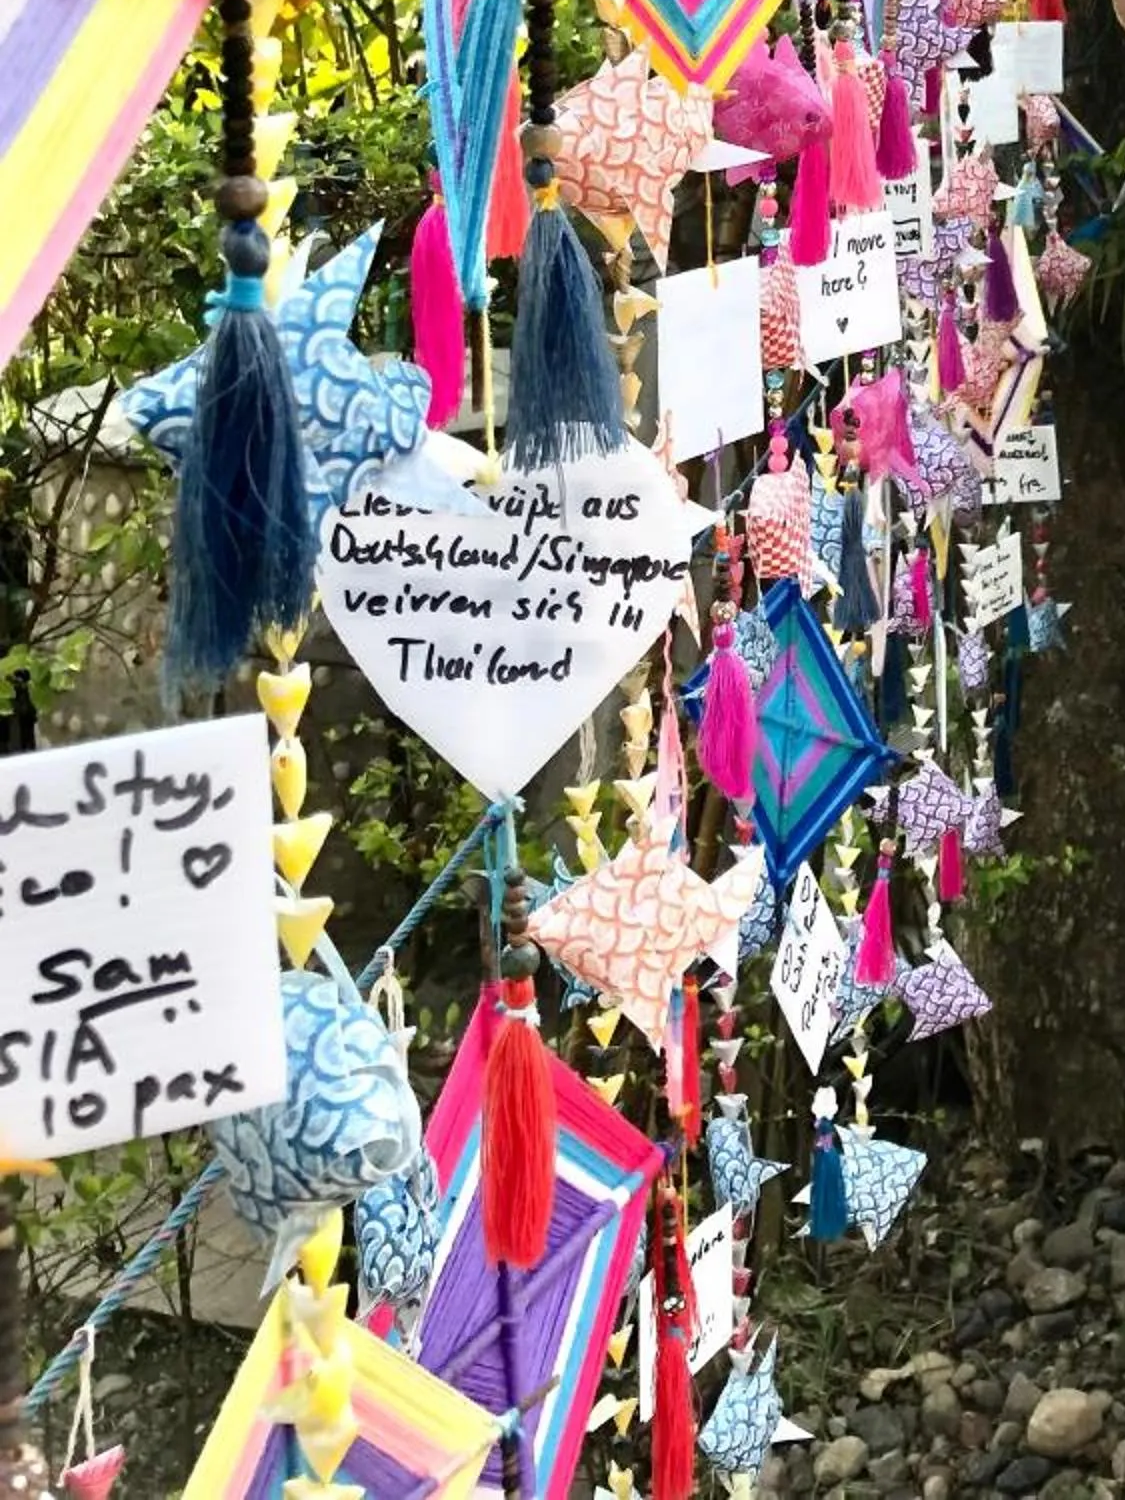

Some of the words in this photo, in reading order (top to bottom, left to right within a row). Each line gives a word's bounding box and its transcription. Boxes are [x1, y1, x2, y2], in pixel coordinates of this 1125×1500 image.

[847, 233, 886, 255] move
[582, 494, 640, 520] aus
[511, 587, 585, 623] sich
[388, 638, 573, 684] Thailand
[31, 948, 192, 1004] Sam
[43, 1091, 107, 1139] 10
[134, 1062, 245, 1138] pax
